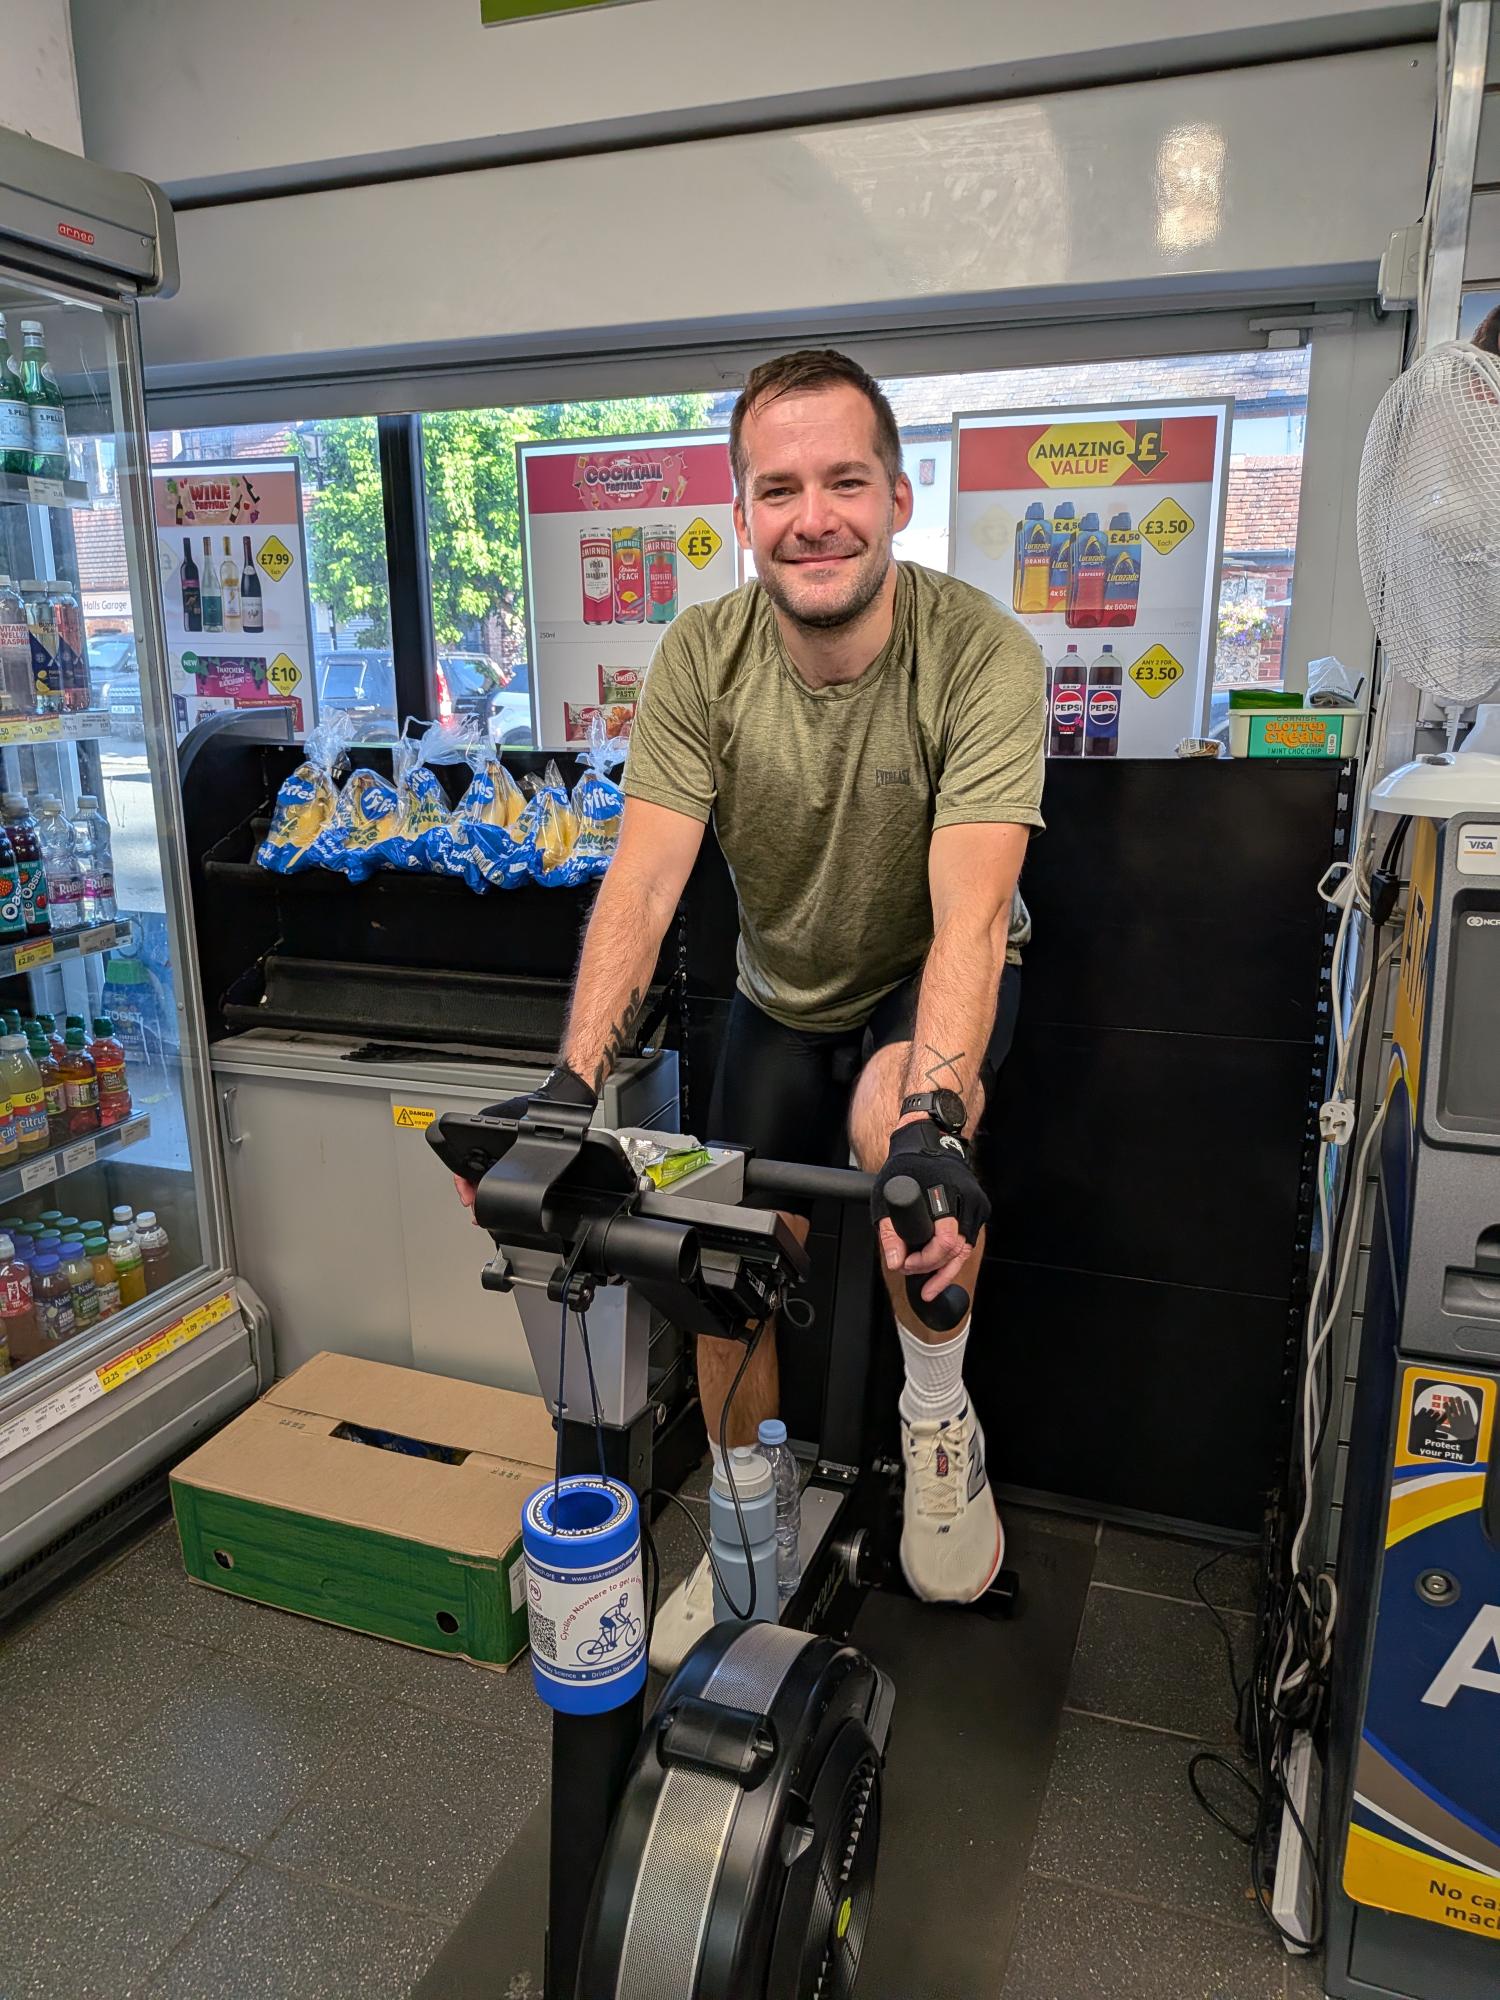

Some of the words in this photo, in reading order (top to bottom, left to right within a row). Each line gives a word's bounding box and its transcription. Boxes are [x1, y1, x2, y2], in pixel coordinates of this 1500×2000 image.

[1035, 440, 1125, 459] AMAZING
[1051, 458, 1109, 475] VALUE
[585, 463, 663, 484] COCKTAIL
[189, 484, 231, 501] WINE
[605, 481, 643, 492] FESTIVAL
[194, 500, 229, 510] FESTIVAL
[1145, 520, 1188, 534] £3.50
[1110, 533, 1140, 543] £4.50
[688, 537, 712, 556] £5
[260, 553, 290, 566] £7.99
[1107, 573, 1139, 582] Lucozade
[83, 601, 100, 610] Halls
[101, 601, 128, 611] Garage
[183, 659, 198, 667] NEW
[271, 667, 297, 682] £10
[1136, 667, 1177, 681] £3.50
[616, 690, 636, 698] PASTY
[1055, 704, 1082, 712] PEPSI
[1090, 704, 1117, 712] PEPSI
[1470, 841, 1494, 850] VISA
[22, 871, 42, 899] Oasis
[409, 1110, 434, 1118] DANGER
[102, 1371, 120, 1386] £2.25
[1424, 1439, 1461, 1451] Protect
[1420, 1448, 1442, 1458] your
[1444, 1451, 1463, 1461] PIN
[560, 1614, 577, 1641] Cycling
[572, 1588, 608, 1615] Nowhere
[609, 1583, 618, 1592] to
[554, 1667, 577, 1679] Science
[591, 1668, 612, 1679] Driven
[1429, 1880, 1462, 1900] No
[1471, 1895, 1500, 1911] ca
